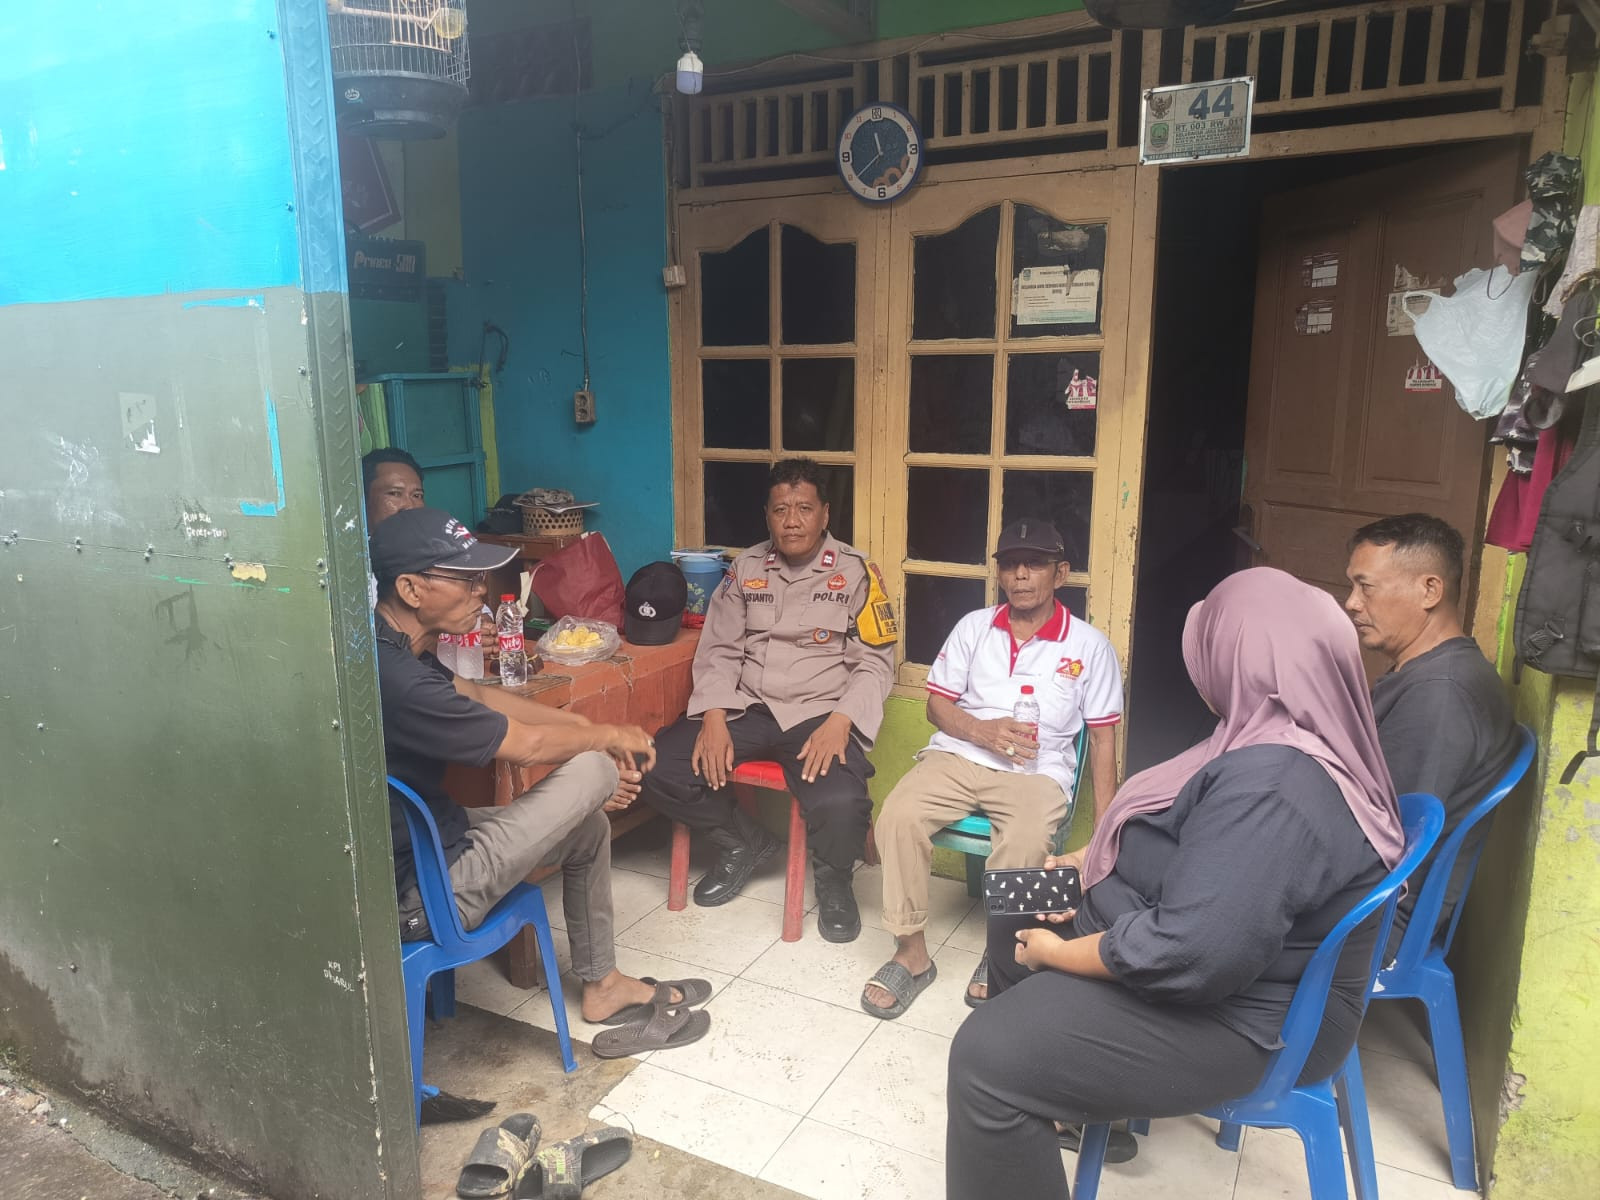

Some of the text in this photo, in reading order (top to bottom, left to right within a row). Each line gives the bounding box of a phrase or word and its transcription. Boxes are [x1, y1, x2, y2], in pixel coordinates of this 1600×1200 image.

[1188, 86, 1234, 120] 44
[909, 144, 918, 154] 3
[841, 152, 850, 162] 9
[877, 187, 886, 198] 6
[813, 592, 850, 604] POLRI
